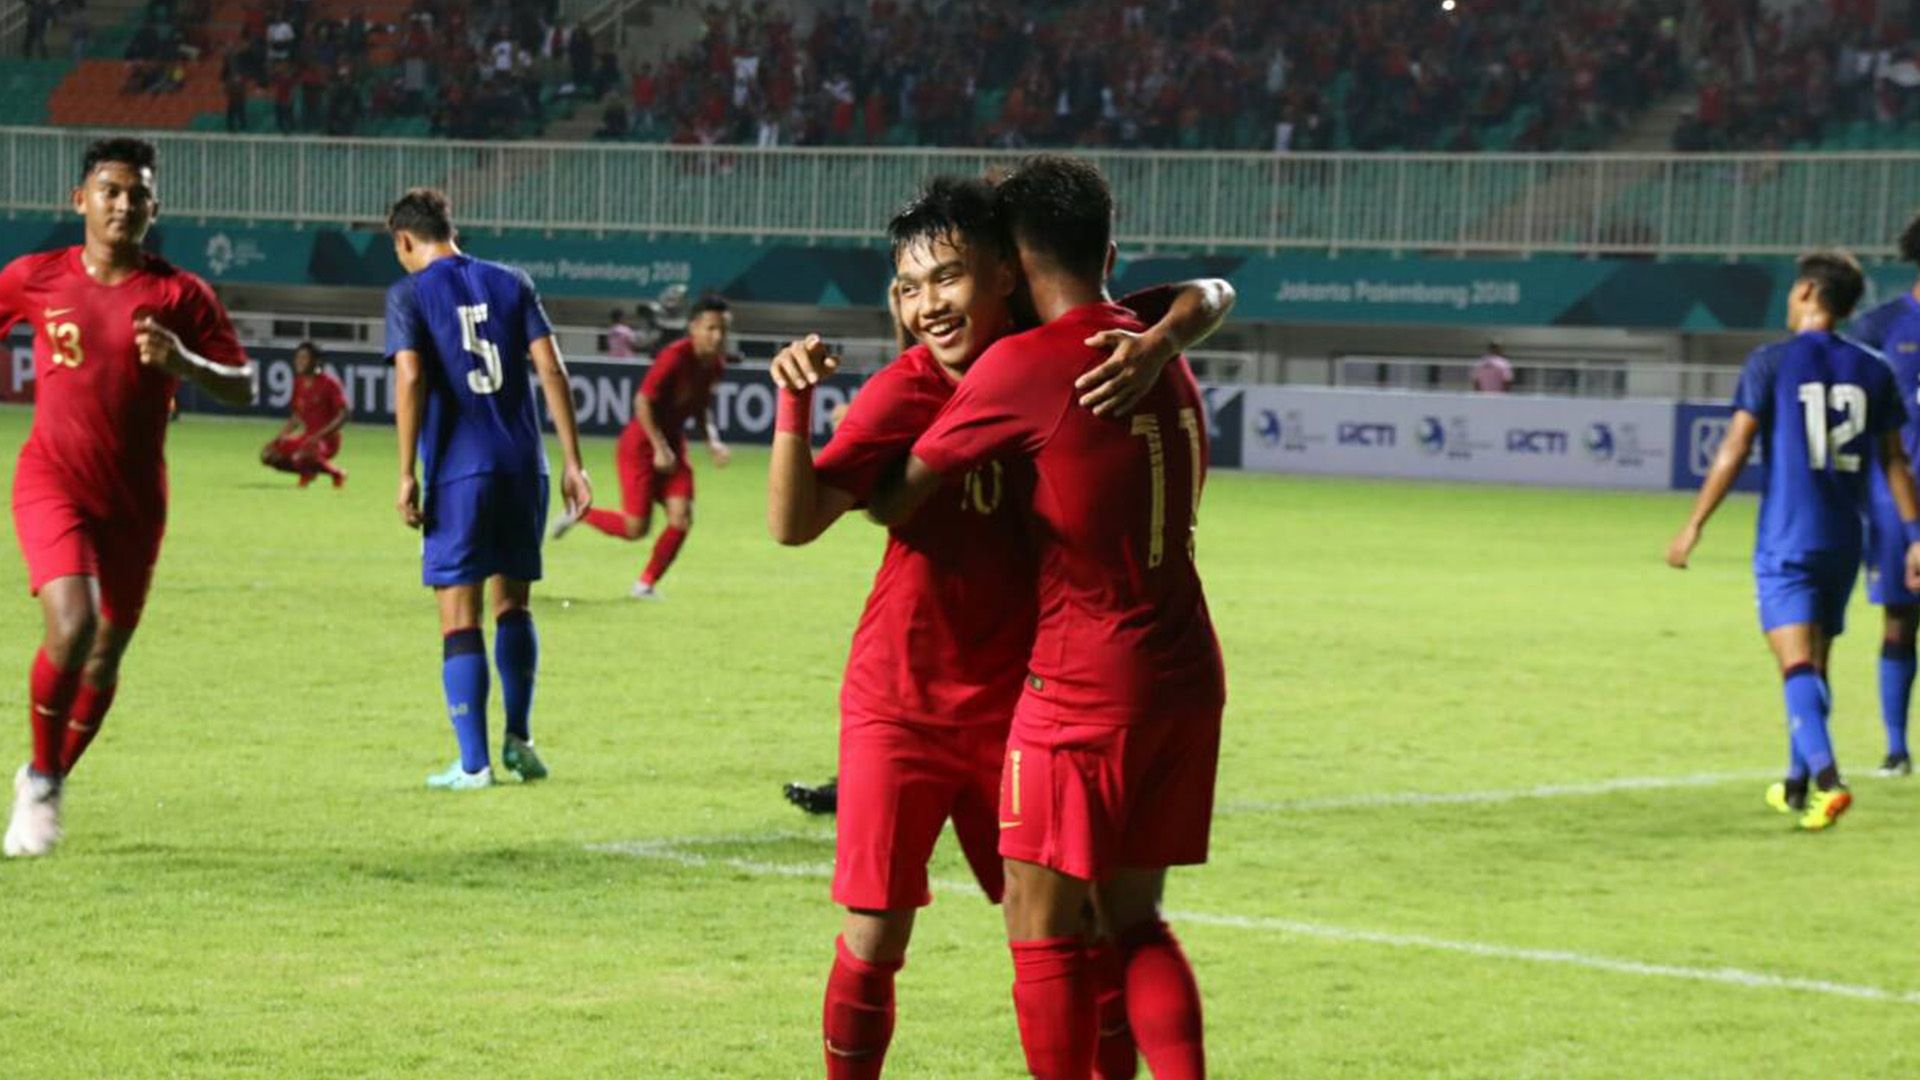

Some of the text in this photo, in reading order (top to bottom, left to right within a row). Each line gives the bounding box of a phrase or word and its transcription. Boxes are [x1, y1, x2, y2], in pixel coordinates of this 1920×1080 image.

[558, 258, 651, 286] Palembang
[1277, 280, 1351, 301] Jakarta
[1354, 279, 1468, 309] Palembang
[46, 322, 83, 368] 13
[457, 303, 503, 394] 5
[1337, 421, 1397, 447] RCTI
[1505, 428, 1568, 454] RCTI
[1798, 382, 1867, 472] 12
[1131, 407, 1200, 570] 11
